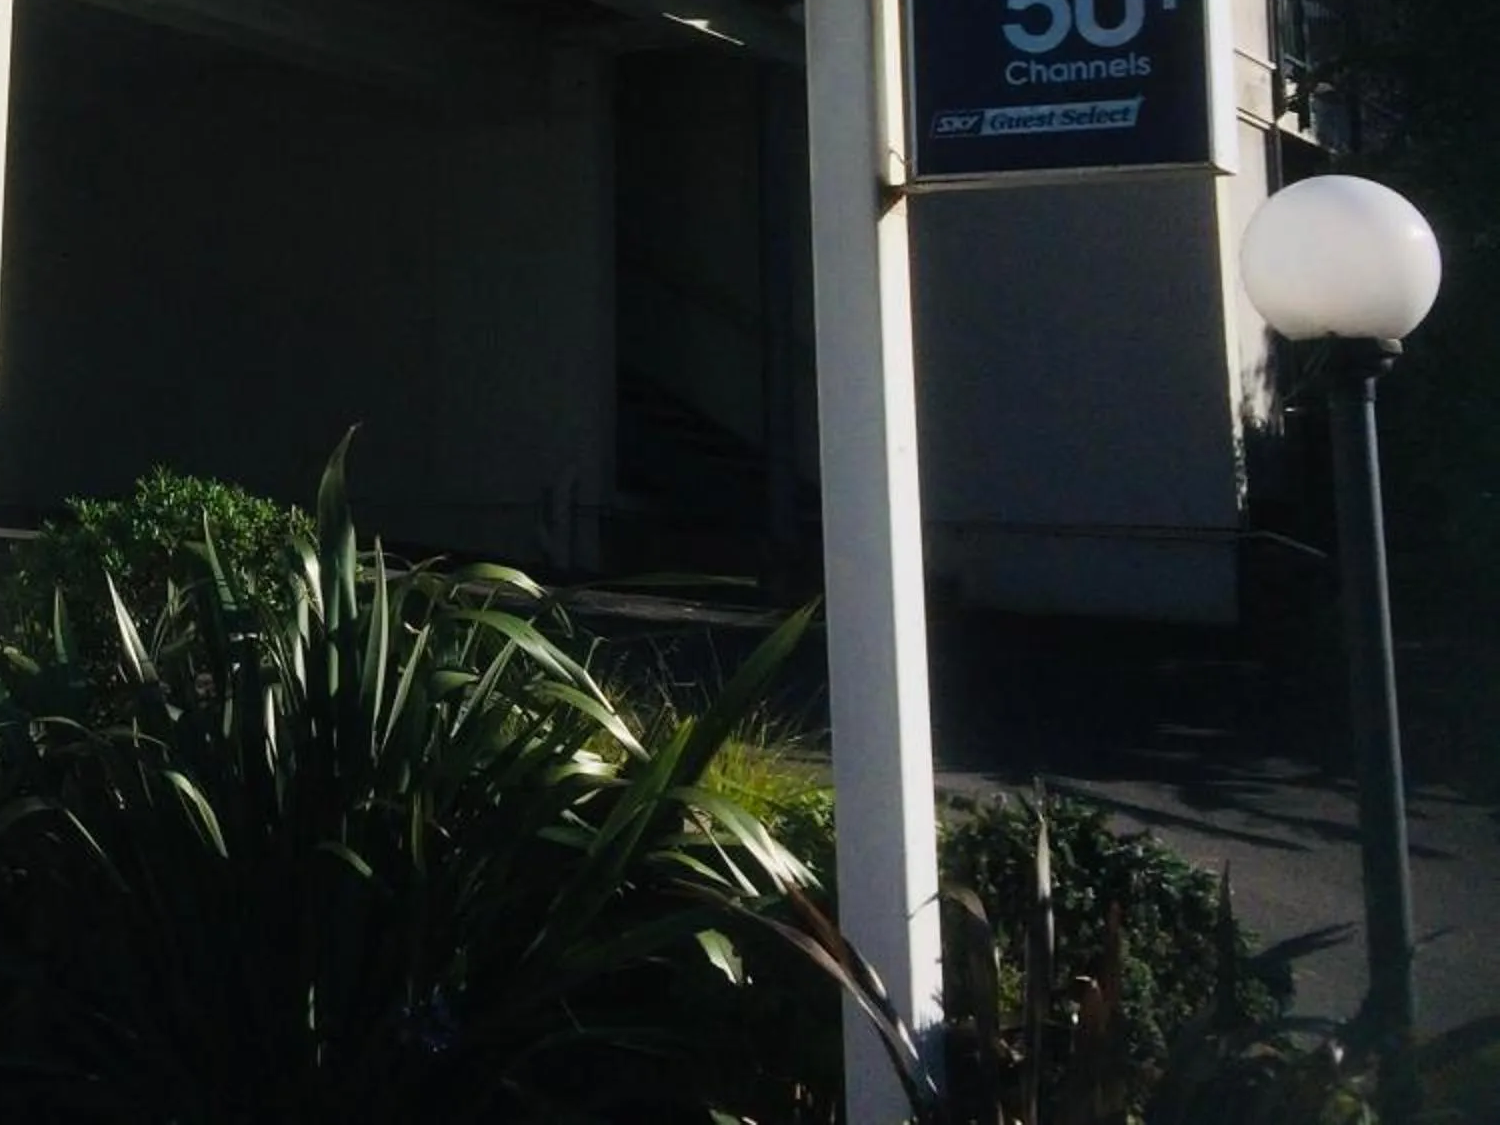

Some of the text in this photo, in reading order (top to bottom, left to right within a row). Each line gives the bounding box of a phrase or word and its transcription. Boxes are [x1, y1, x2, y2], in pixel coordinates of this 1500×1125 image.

[1005, 52, 1152, 85] Channels
[990, 110, 1056, 132] Guest
[1059, 104, 1131, 126] Select
